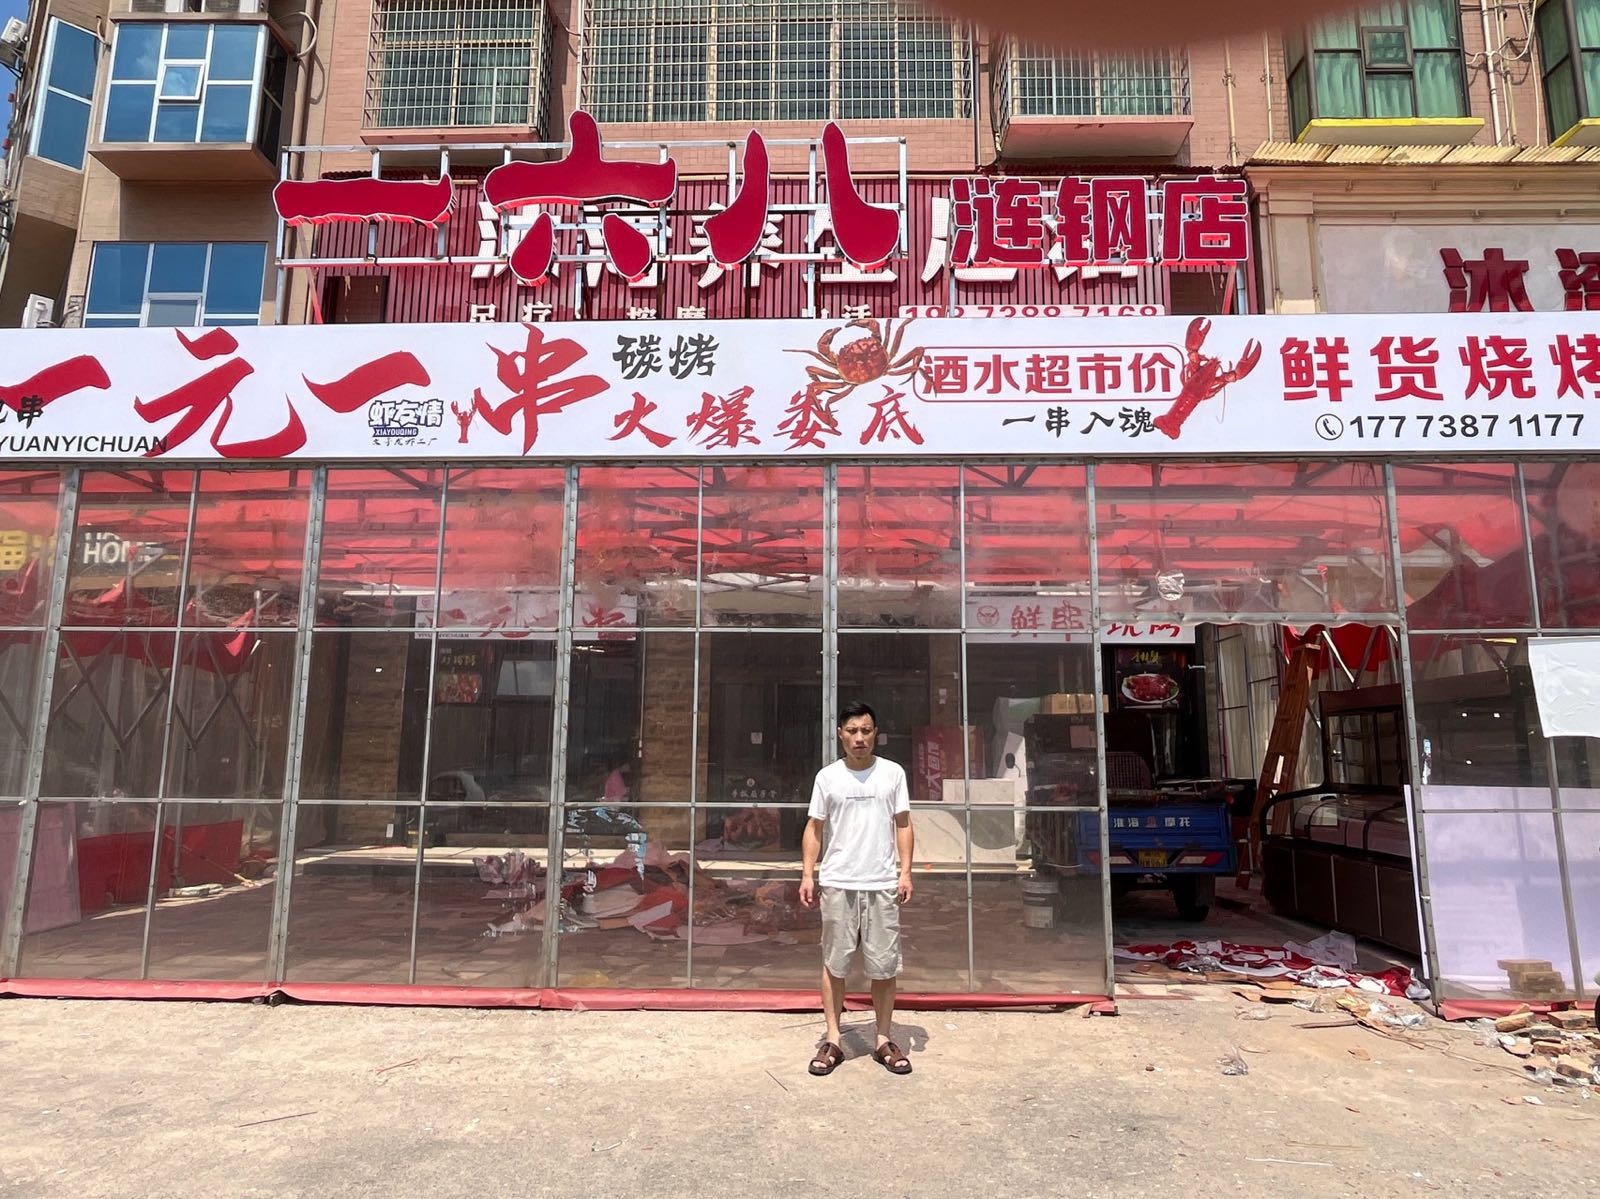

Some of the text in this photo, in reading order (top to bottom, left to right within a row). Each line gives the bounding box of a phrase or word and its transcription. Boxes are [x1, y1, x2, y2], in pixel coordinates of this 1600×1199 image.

[273, 109, 902, 286] 一六八
[951, 175, 1249, 266] 涟钢店
[612, 333, 720, 380] 碳烤
[923, 352, 1176, 394] 酒水超市价
[1280, 334, 1600, 402] 鲜货烧烤
[368, 398, 444, 427] 虾友情
[374, 428, 418, 436] XIAYOUQING
[605, 384, 924, 452] 火爆娄底
[1002, 406, 1155, 438] 一串入魂
[1350, 412, 1585, 438] 177 7387 1177
